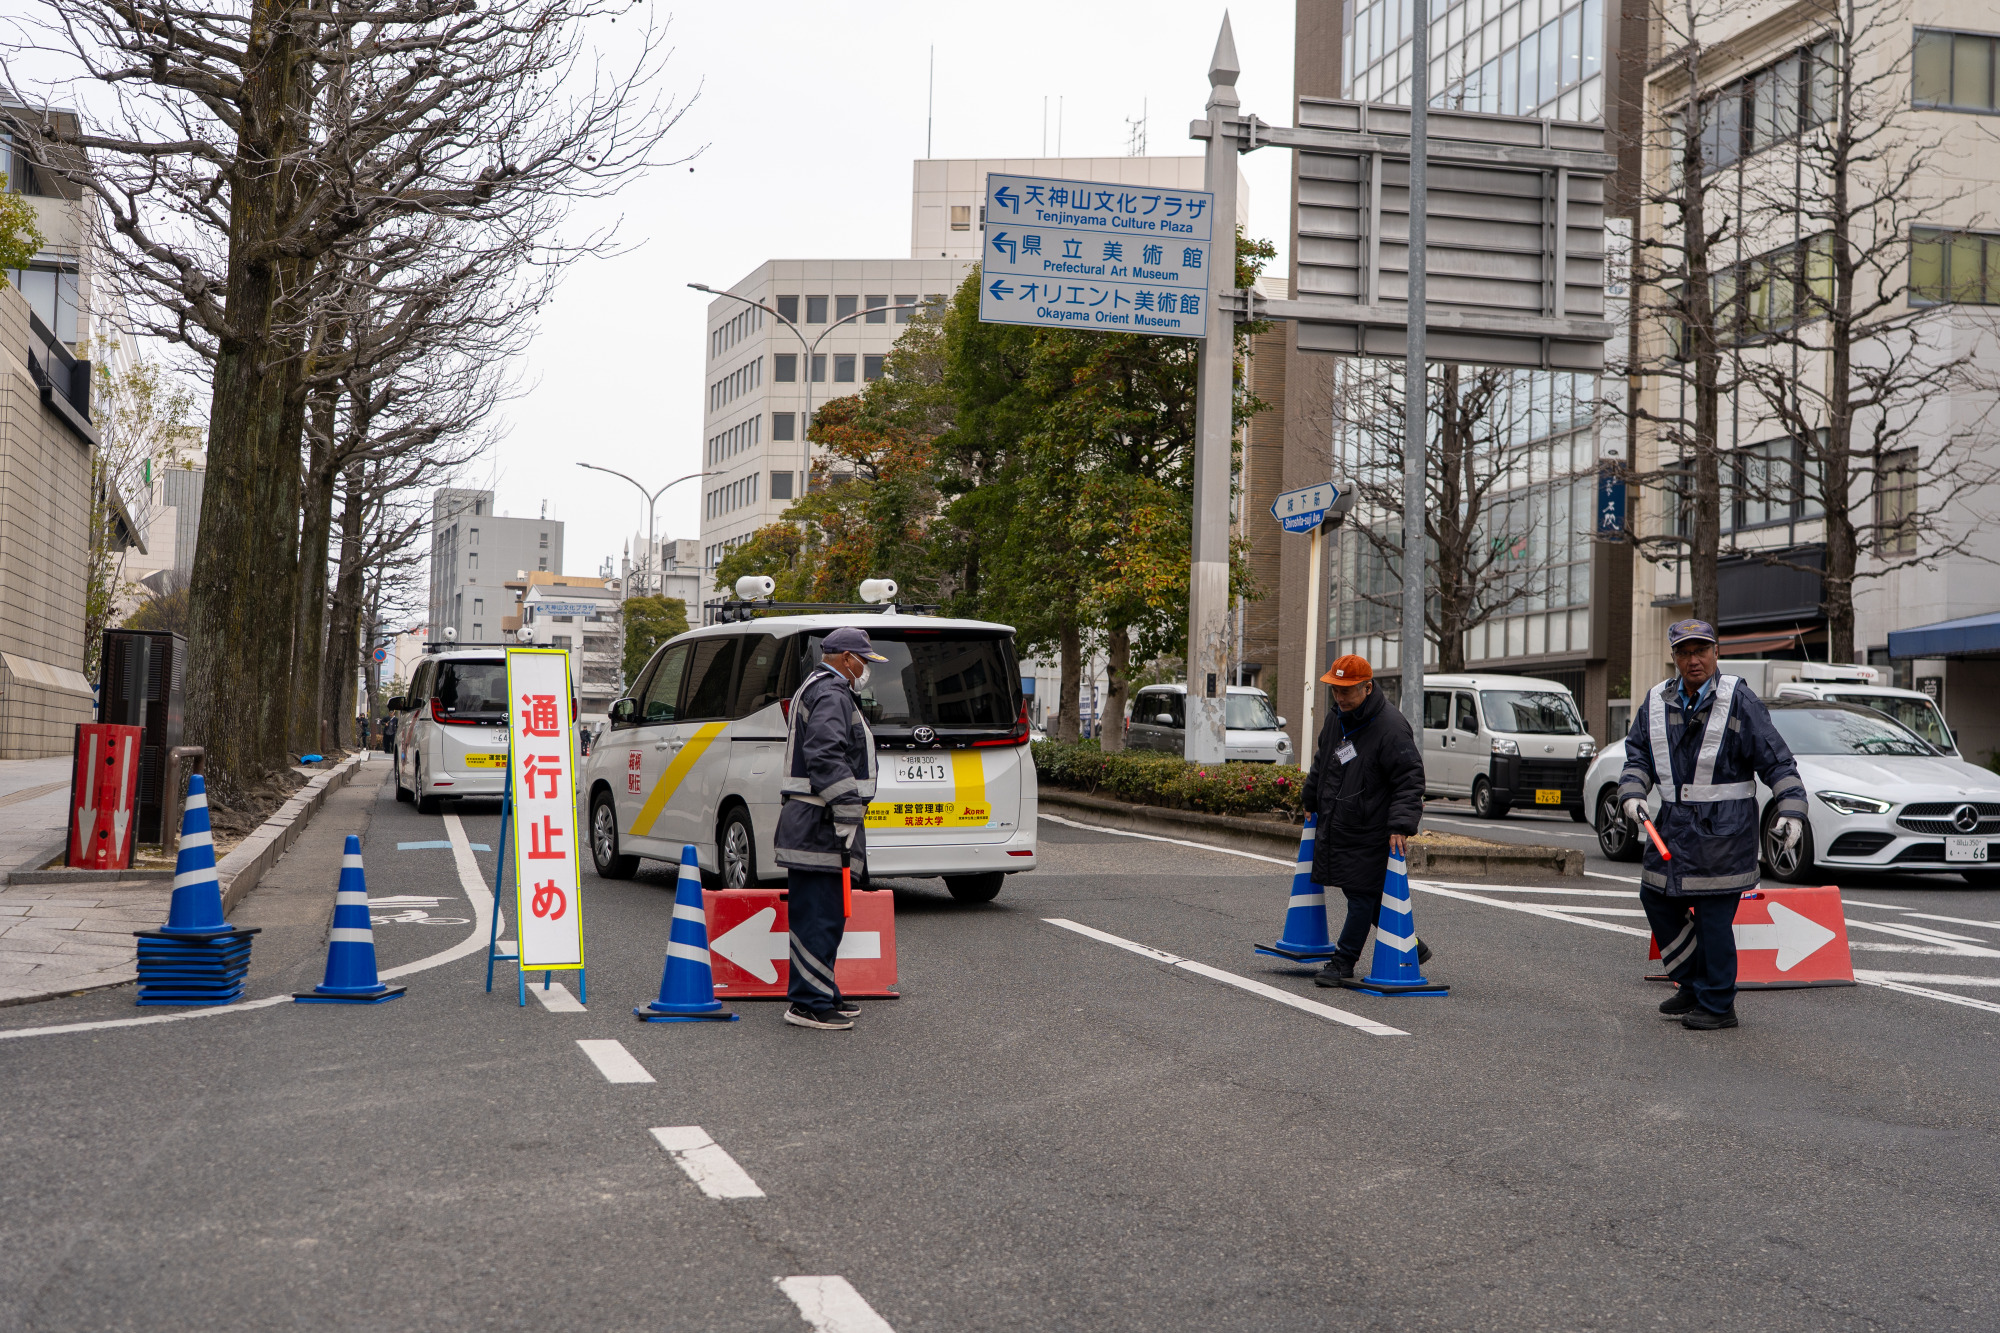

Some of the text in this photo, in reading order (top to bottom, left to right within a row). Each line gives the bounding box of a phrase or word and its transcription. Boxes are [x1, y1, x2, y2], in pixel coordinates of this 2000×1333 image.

[1024, 184, 1207, 219] 天神山文化プラザ
[1036, 209, 1193, 234] Tenjinyama Culture Plaza
[1021, 234, 1203, 269] 県立美術館
[1043, 260, 1179, 281] Prefectural Art Museum
[1018, 282, 1201, 316] オリエント美術館
[1036, 306, 1181, 328] Okayama Orient Museum
[629, 774, 640, 791] 駅伝
[907, 765, 945, 779] 64-13
[521, 693, 568, 921] 通行止め
[904, 816, 944, 826] 筑波大学
